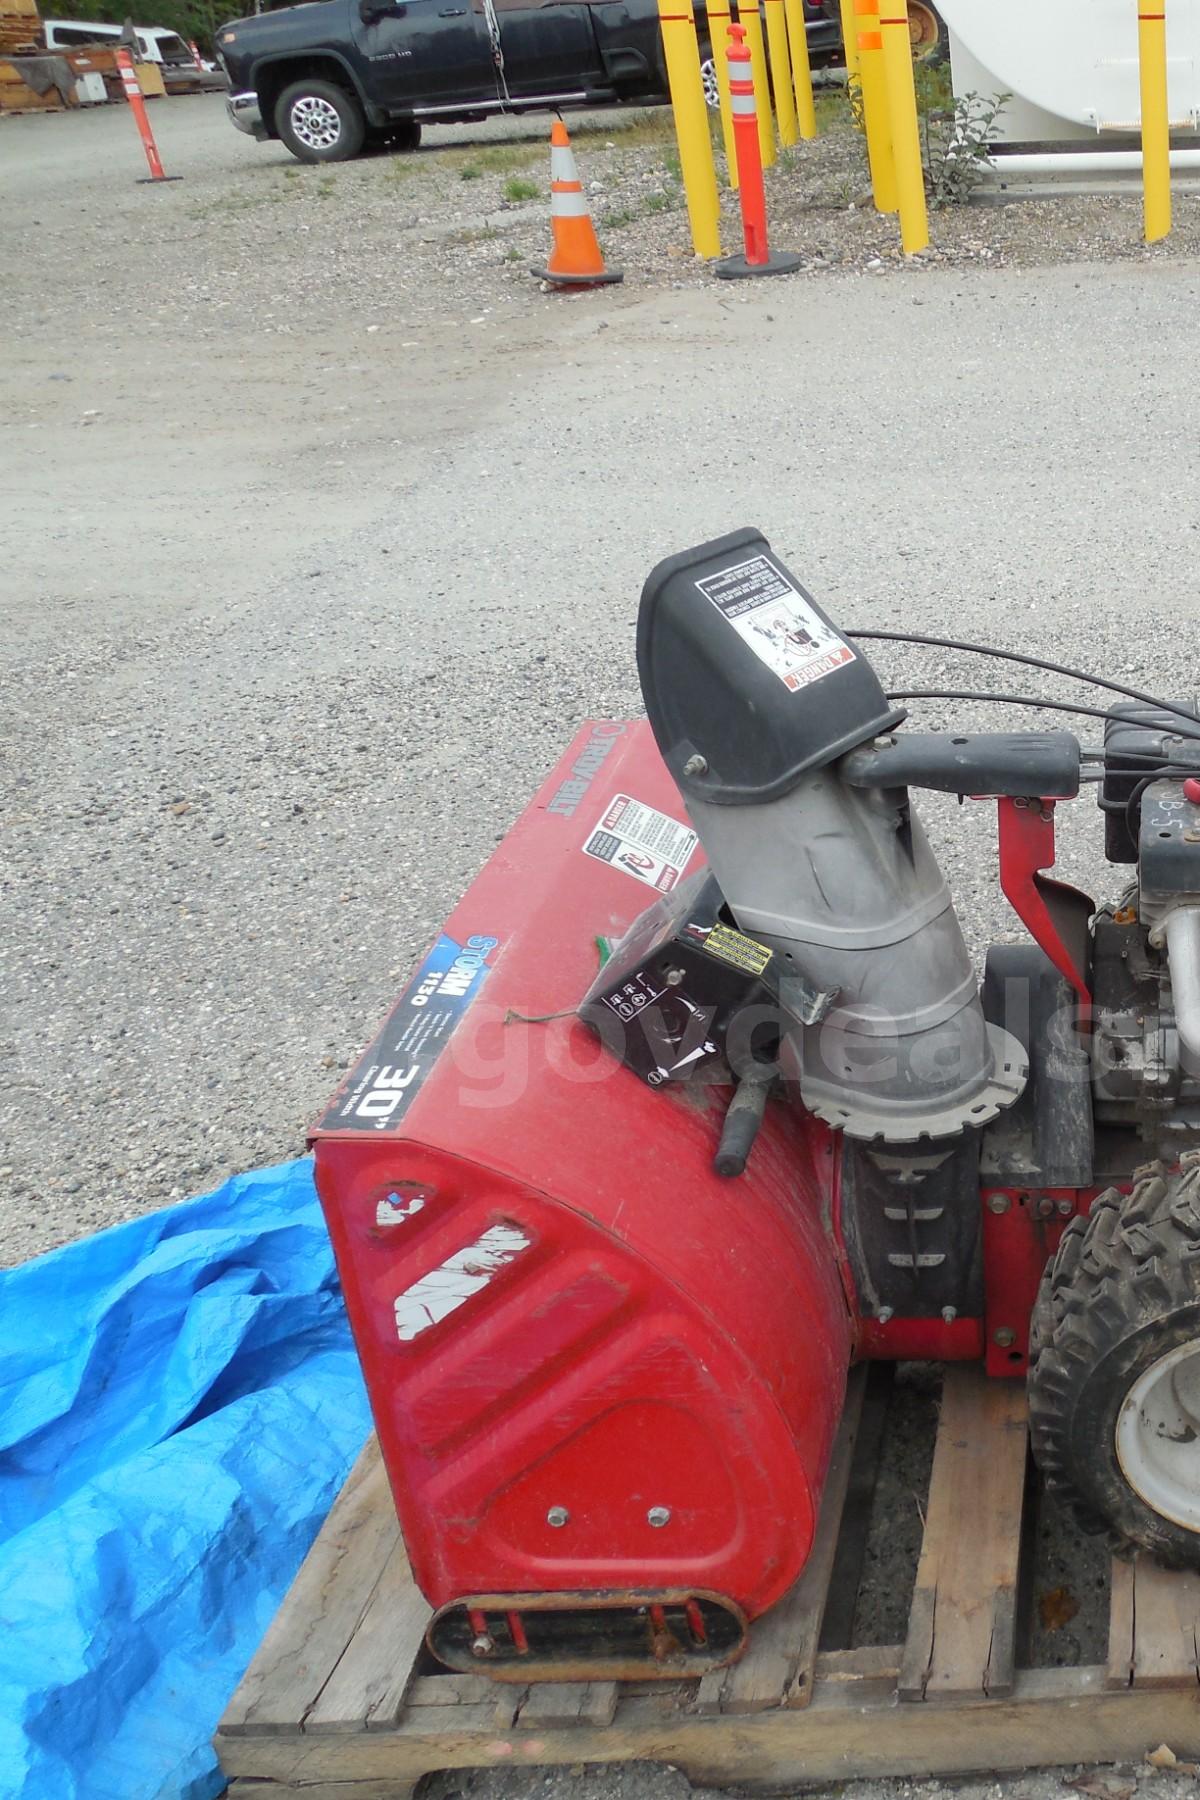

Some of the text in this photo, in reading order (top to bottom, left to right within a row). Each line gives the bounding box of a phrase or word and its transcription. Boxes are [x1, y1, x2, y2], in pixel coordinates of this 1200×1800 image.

[789, 655, 835, 685] DANGER
[546, 737, 617, 818] TROY-BILT
[410, 971, 444, 1006] 1130
[436, 936, 499, 996] STORM
[338, 1065, 380, 1116] Clearing Width
